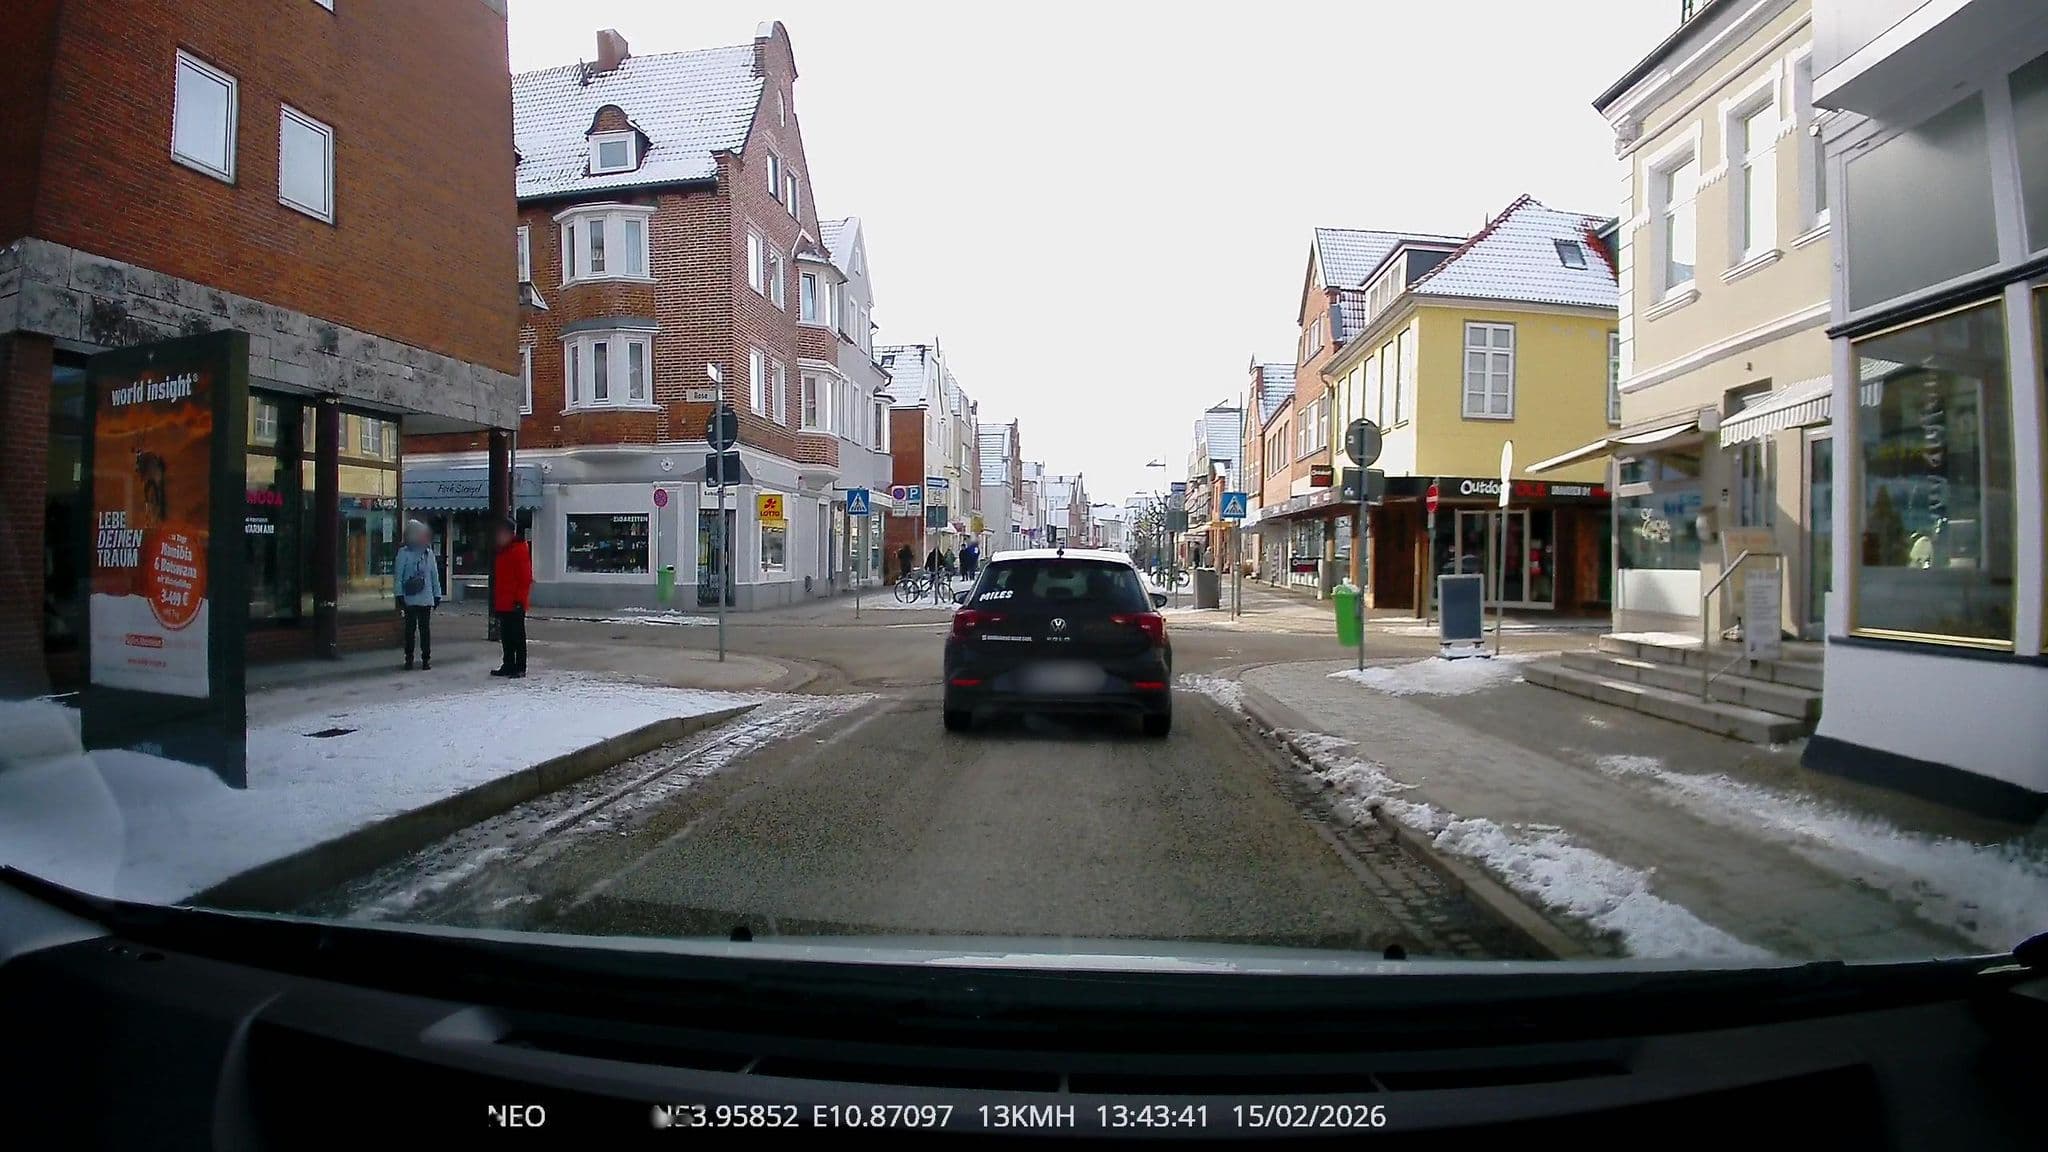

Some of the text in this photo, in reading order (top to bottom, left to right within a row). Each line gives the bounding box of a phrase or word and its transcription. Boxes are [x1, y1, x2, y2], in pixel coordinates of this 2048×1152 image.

[111, 381, 144, 407] world
[98, 511, 127, 529] LEBE
[97, 529, 143, 549] DEINEN
[97, 548, 139, 568] TRAUM
[979, 590, 1014, 602] MILES
